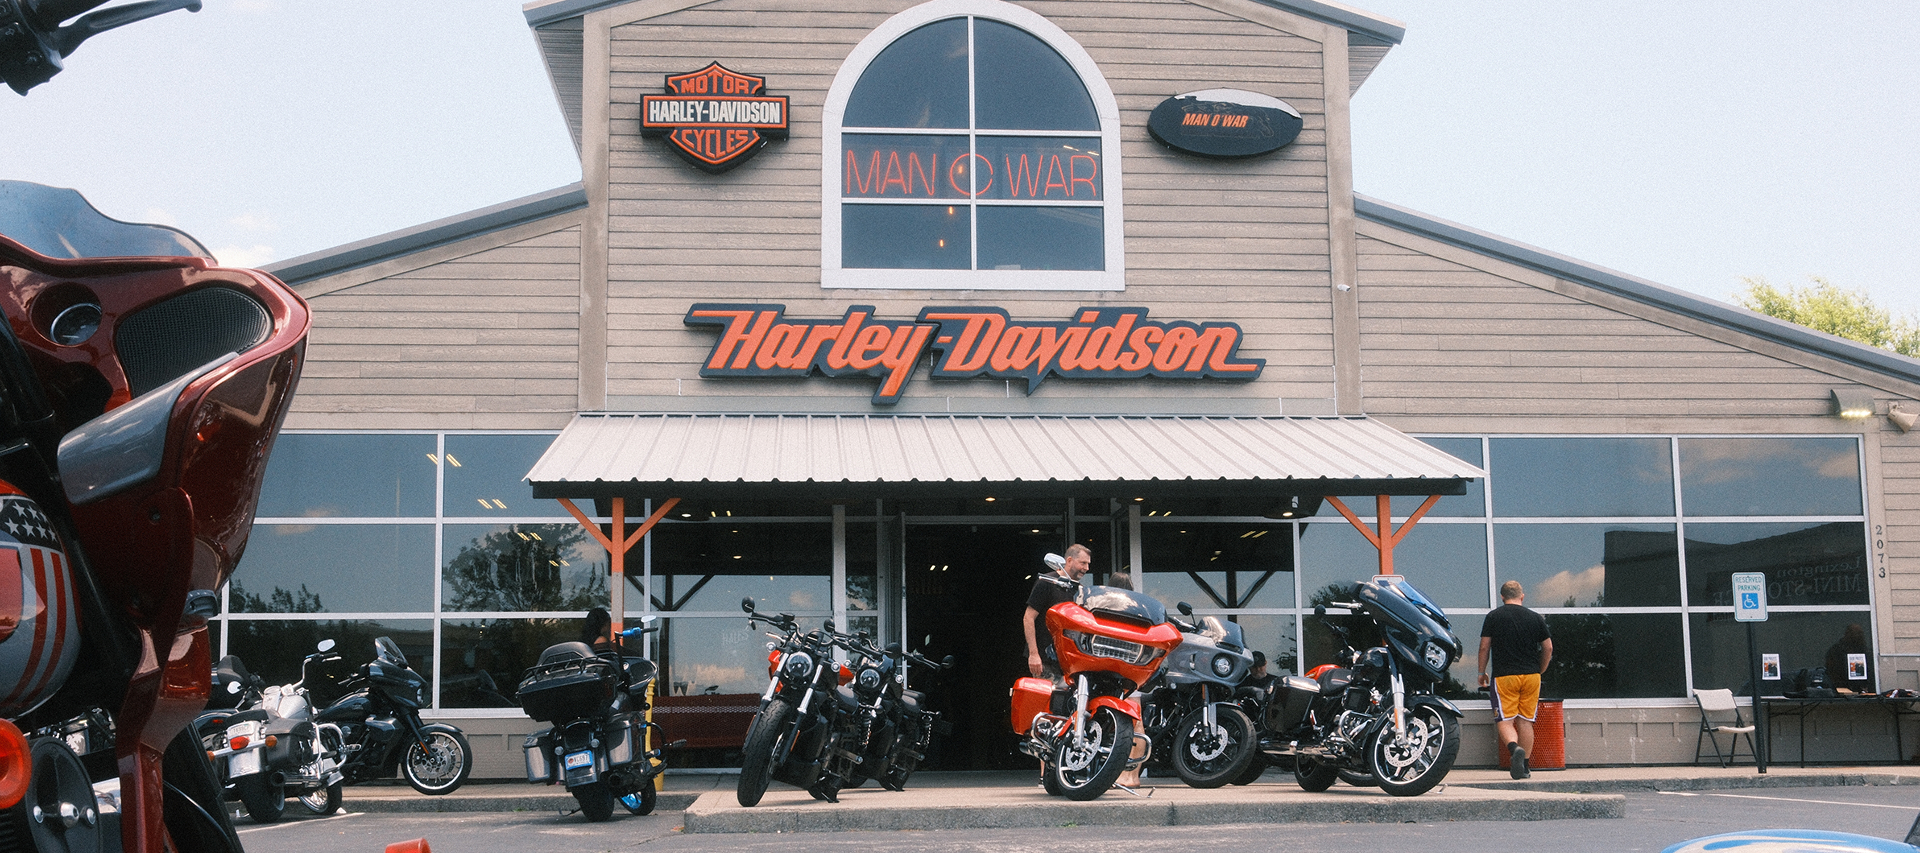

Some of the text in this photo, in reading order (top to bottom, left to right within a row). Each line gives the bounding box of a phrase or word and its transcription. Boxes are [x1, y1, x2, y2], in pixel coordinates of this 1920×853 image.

[680, 69, 749, 94] MOTOR
[650, 101, 781, 124] HARLEY-DAVIDSON
[1182, 112, 1211, 126] MAN
[681, 129, 749, 159] CYCLES
[846, 150, 937, 196] MAN
[1006, 153, 1097, 197] WAR
[690, 308, 1260, 398] Harley-Davidson
[1875, 524, 1886, 579] 2073
[1735, 576, 1763, 584] RESERVED
[1737, 584, 1761, 592] PARKING
